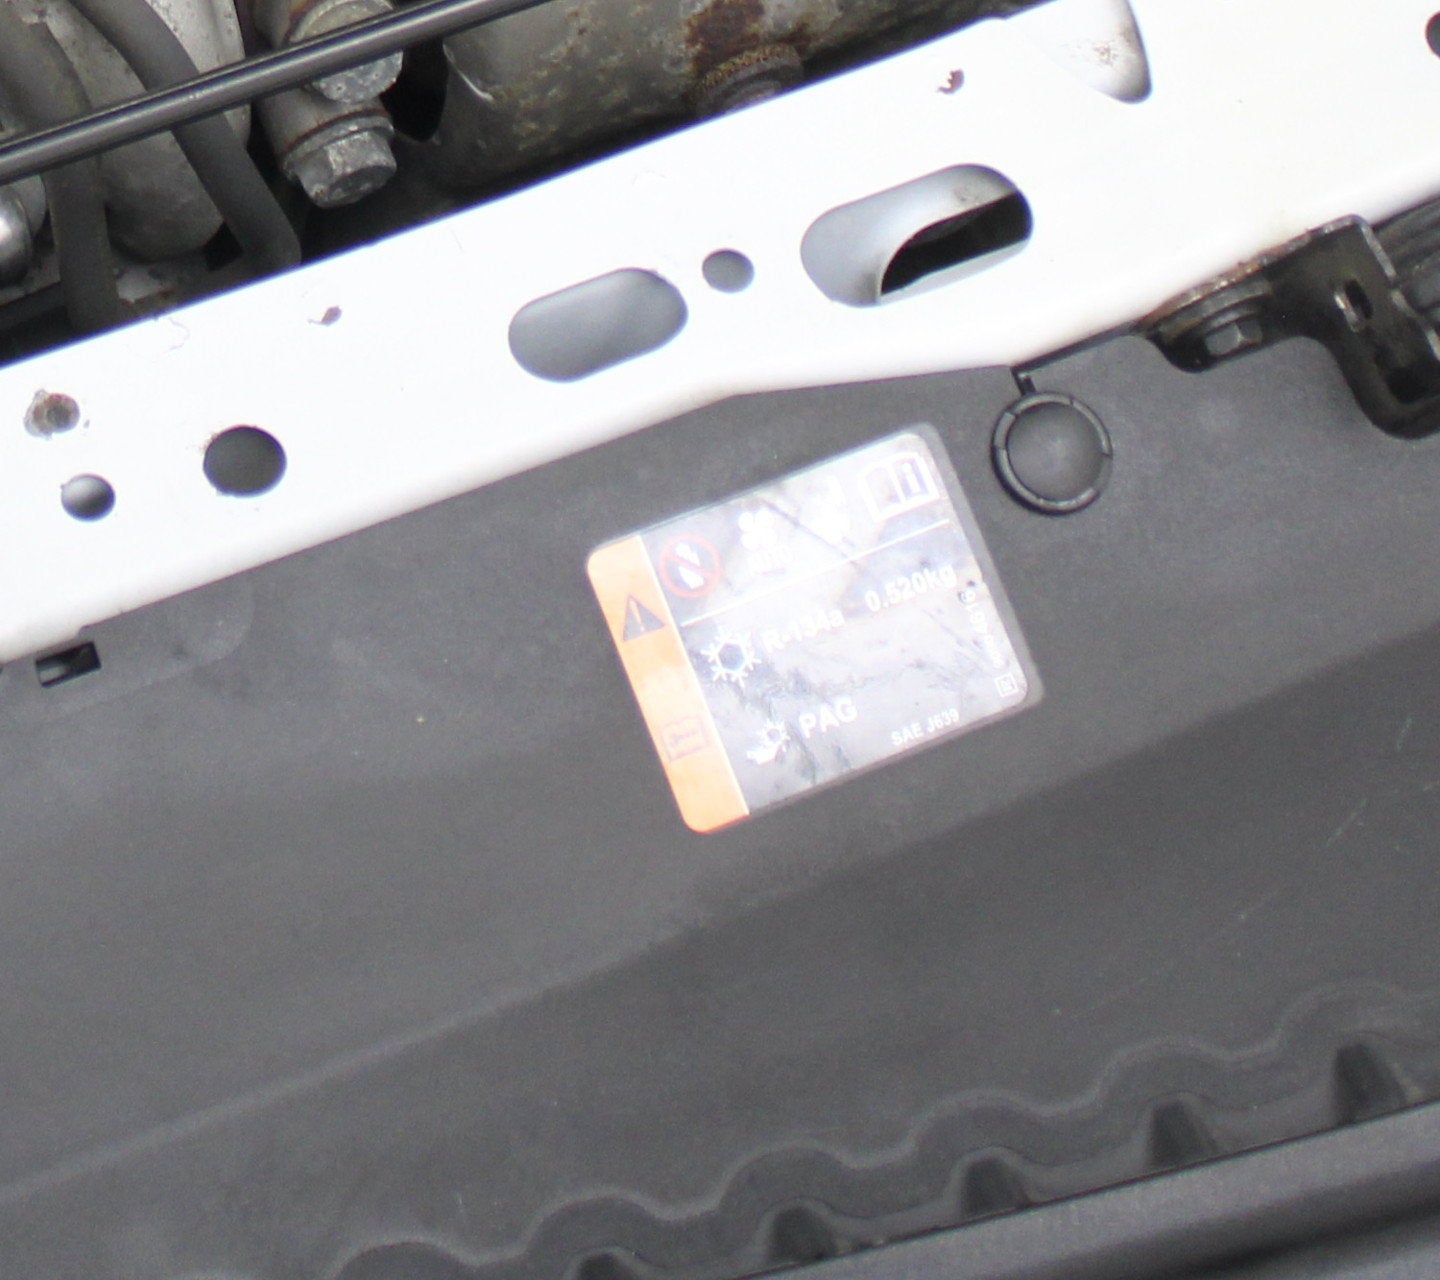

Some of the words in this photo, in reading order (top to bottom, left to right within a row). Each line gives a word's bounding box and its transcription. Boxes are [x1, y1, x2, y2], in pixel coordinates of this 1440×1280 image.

[863, 564, 957, 613] 0.520kg
[797, 694, 860, 740] PAG
[890, 722, 924, 748] SAE
[926, 707, 961, 734] J639
